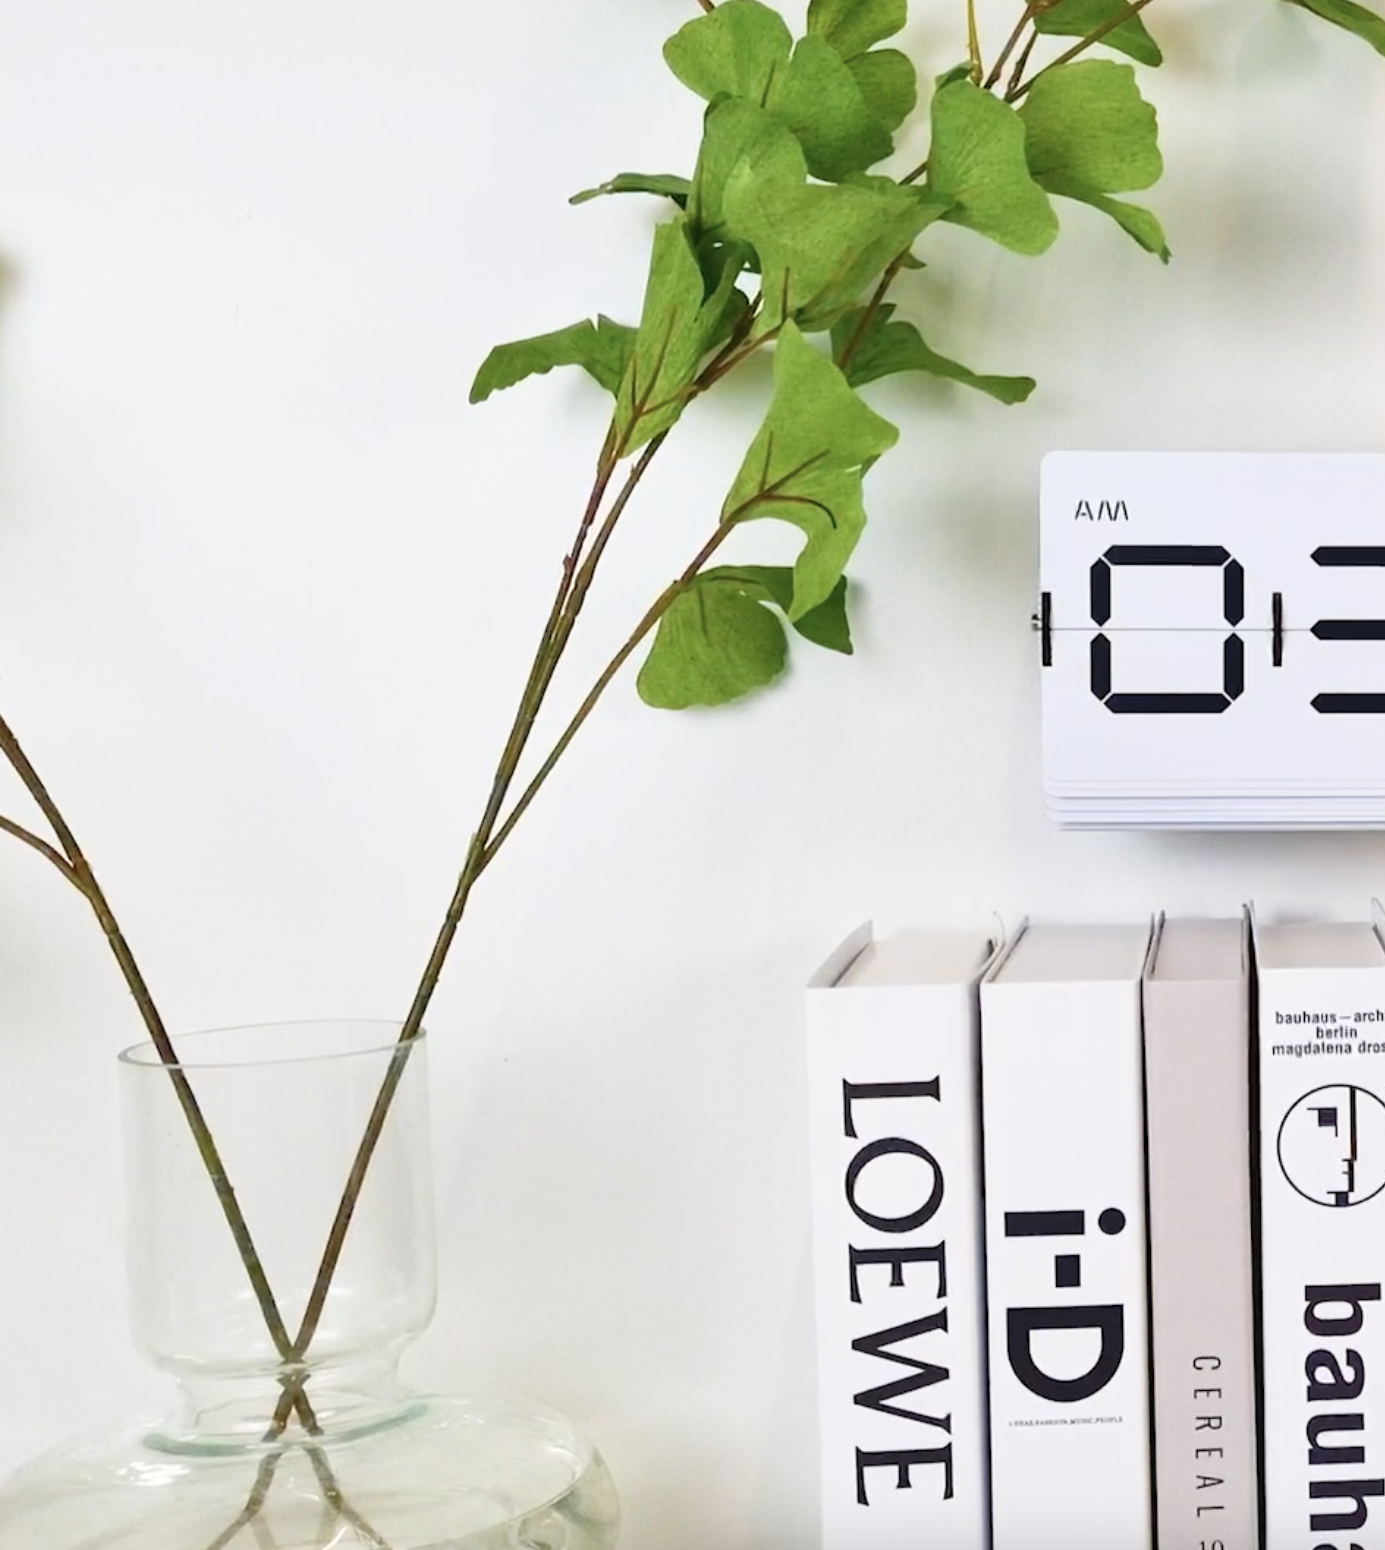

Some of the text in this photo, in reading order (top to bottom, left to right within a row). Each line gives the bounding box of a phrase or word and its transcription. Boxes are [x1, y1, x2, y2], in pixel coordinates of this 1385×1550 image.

[1074, 499, 1128, 521] AM
[1272, 1042, 1352, 1058] magdalena
[1316, 1026, 1358, 1039] berlin
[843, 1076, 953, 1506] LOEWE
[1004, 1207, 1126, 1403] i-D
[1193, 1355, 1225, 1518] CEREAL
[1304, 1283, 1385, 1550] bauh
